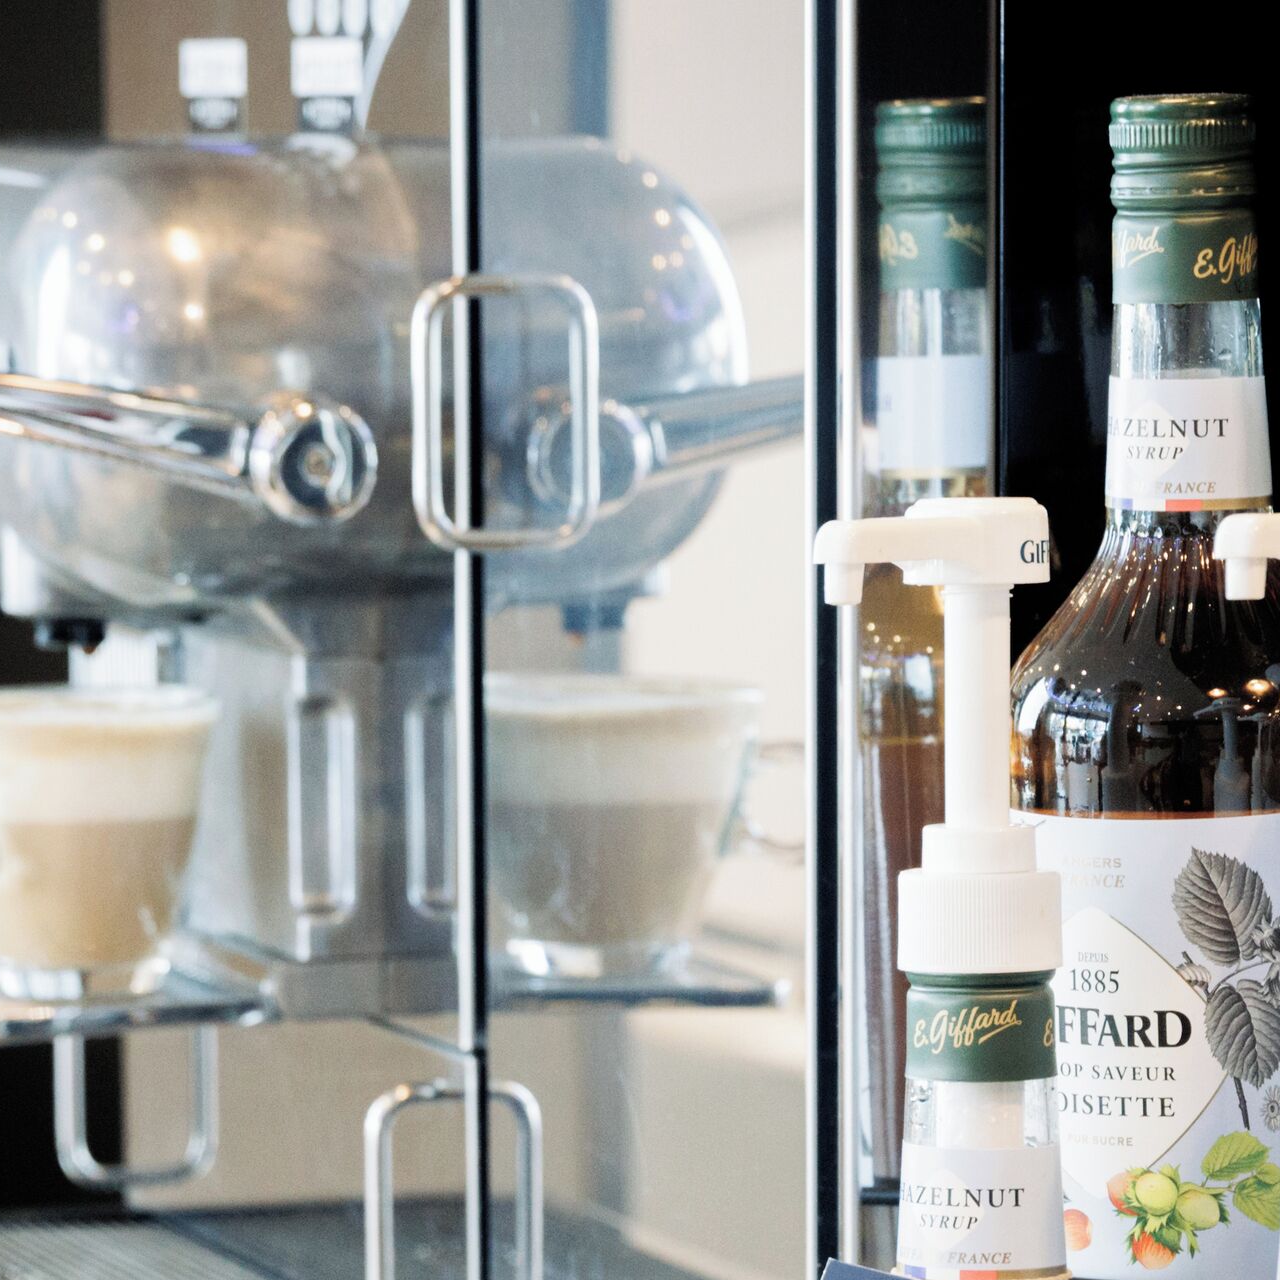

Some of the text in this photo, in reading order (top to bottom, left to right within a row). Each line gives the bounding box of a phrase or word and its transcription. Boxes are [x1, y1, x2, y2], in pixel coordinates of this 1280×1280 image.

[1127, 446, 1183, 460] SYRUP
[1157, 481, 1217, 494] RANCE
[1070, 968, 1119, 994] 1885
[1056, 1004, 1192, 1048] FFARD
[1091, 1064, 1176, 1082] SAVEUR
[920, 1214, 978, 1230] SYRUP
